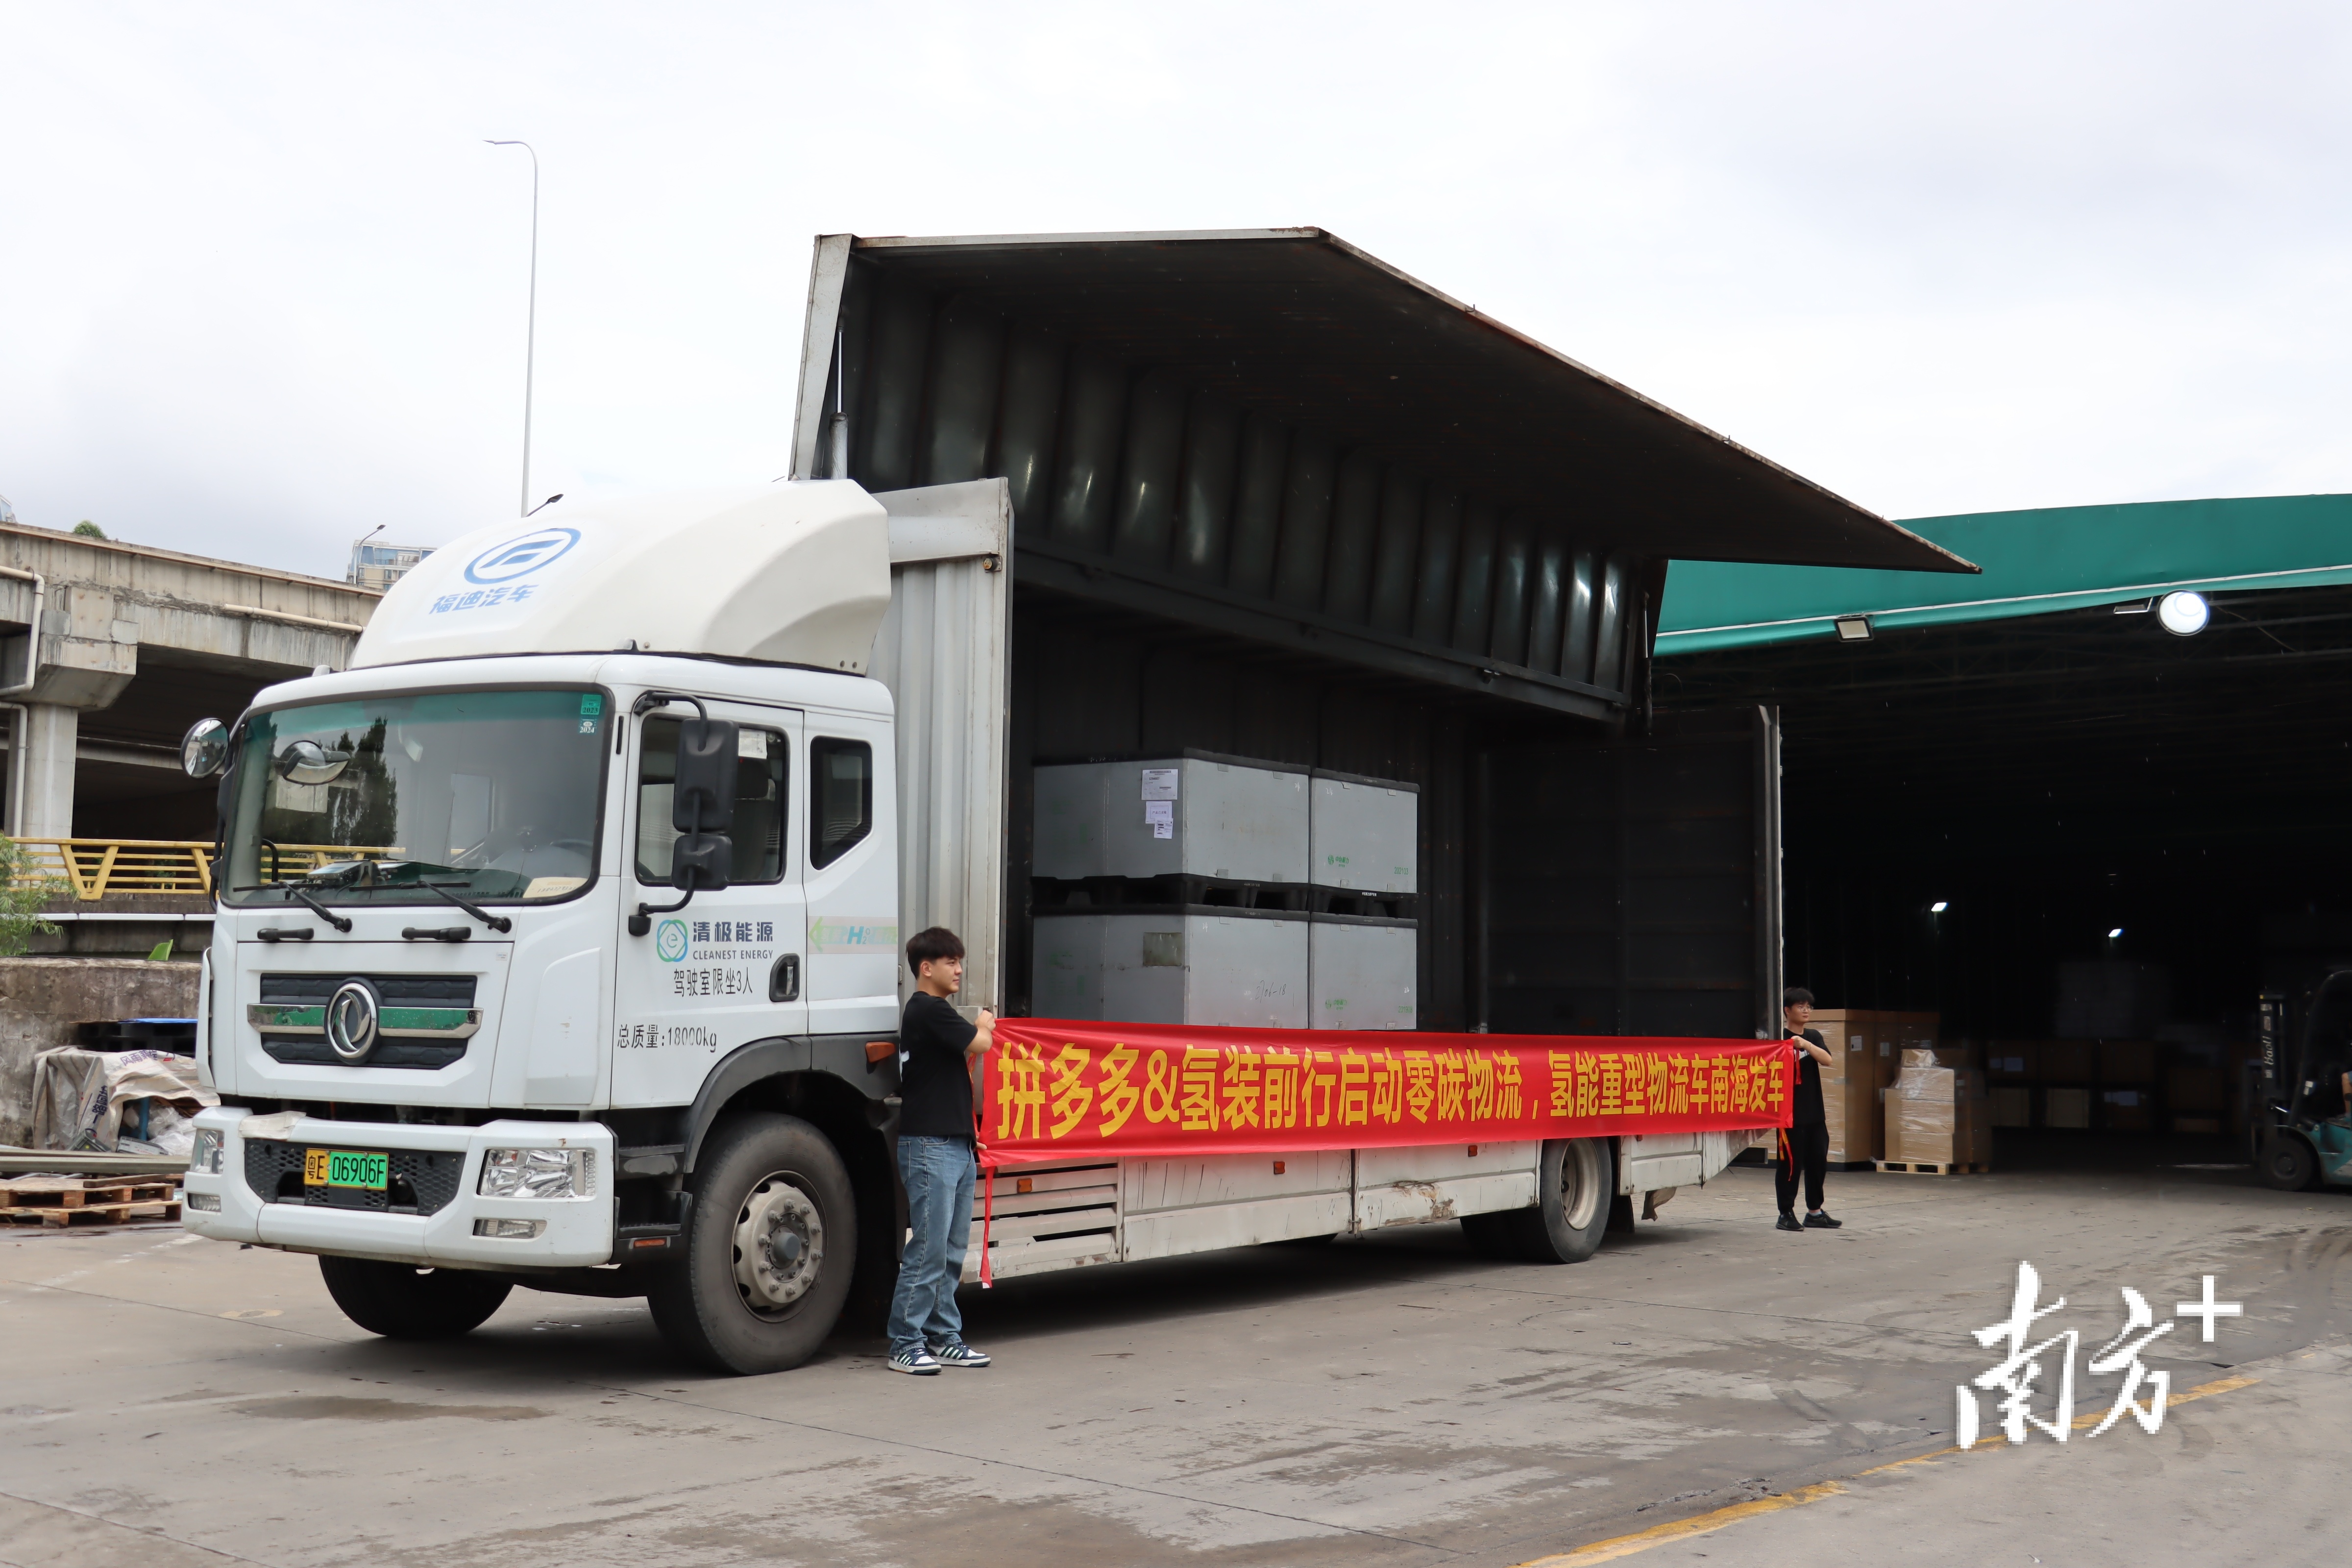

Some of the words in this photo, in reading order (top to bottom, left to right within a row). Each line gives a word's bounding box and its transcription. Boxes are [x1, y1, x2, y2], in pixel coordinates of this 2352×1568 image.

[429, 584, 539, 614] 福迪汽车
[693, 921, 773, 942] 清极能源
[693, 950, 737, 960] CLEANEST
[740, 950, 773, 960] ENERGY
[674, 967, 753, 997] 驾驶室限坐3人
